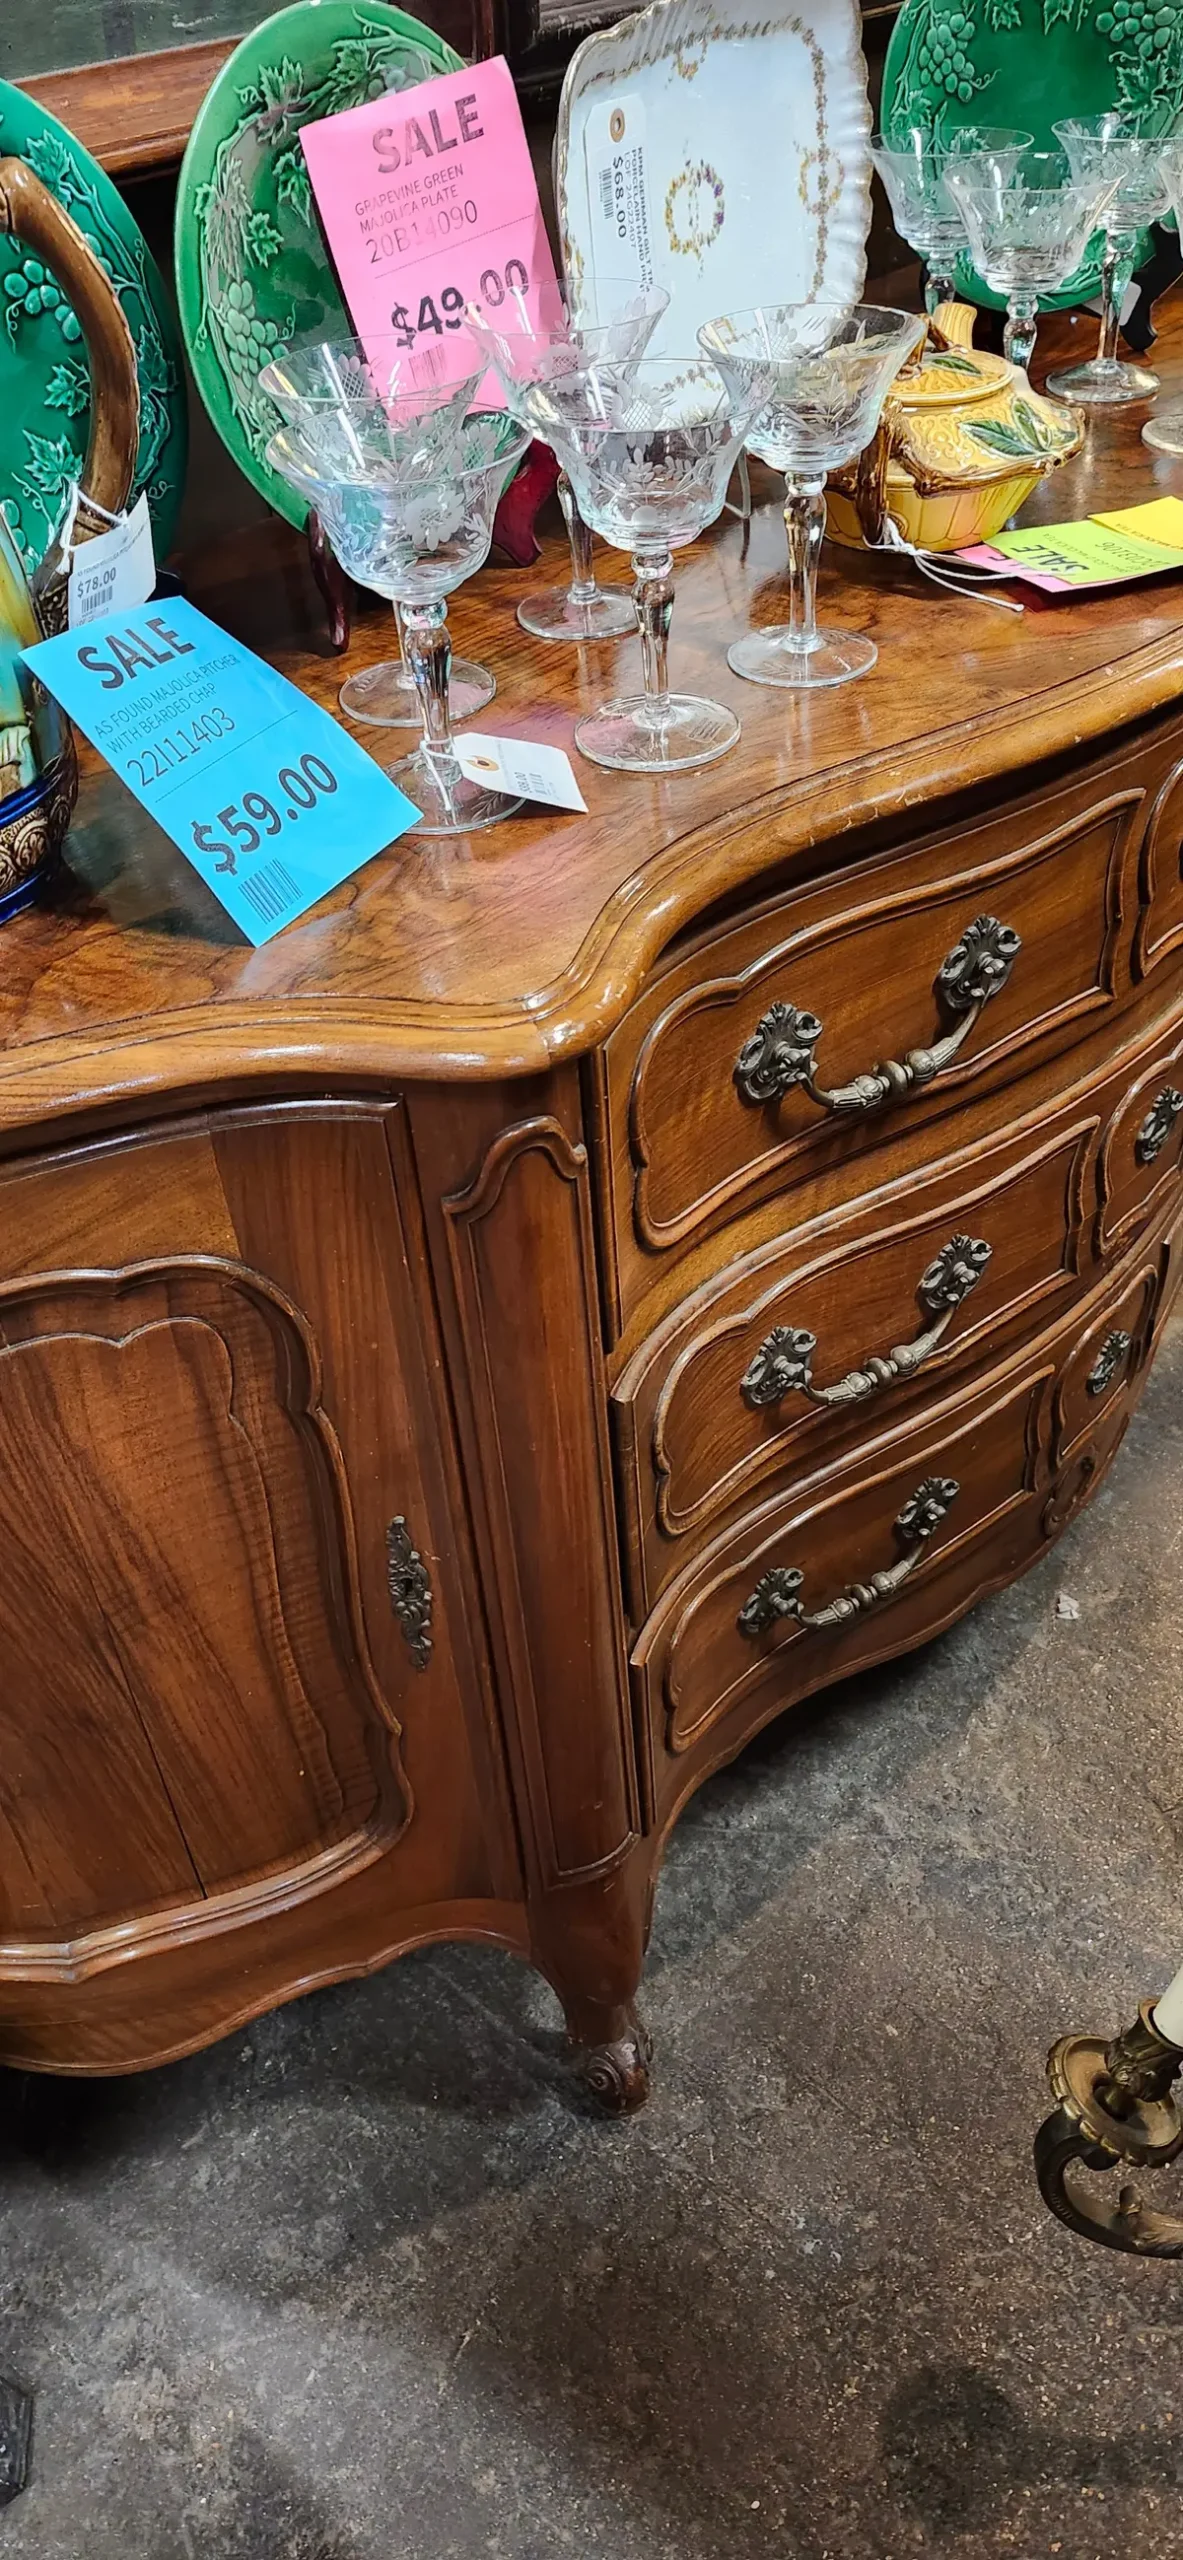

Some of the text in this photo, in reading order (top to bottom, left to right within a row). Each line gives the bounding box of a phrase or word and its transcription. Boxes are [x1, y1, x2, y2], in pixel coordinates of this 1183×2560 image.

[372, 93, 484, 173] SALE
[355, 163, 464, 216] GRAPEVINE GREEN
[360, 184, 459, 234] MAJOLICA PLATE
[612, 156, 627, 238] $68.00
[631, 149, 641, 222] PORCELAIN
[366, 200, 477, 264] 20B14090
[391, 259, 529, 350] $49.00
[77, 567, 117, 598] $78.00
[1010, 544, 1090, 571] SALE
[77, 617, 196, 689] SALE
[94, 654, 240, 740] AS FOUND MAJOLICA PITCHER
[106, 682, 217, 754] WITH BEARDED CHAP
[191, 753, 338, 876] $59.00
